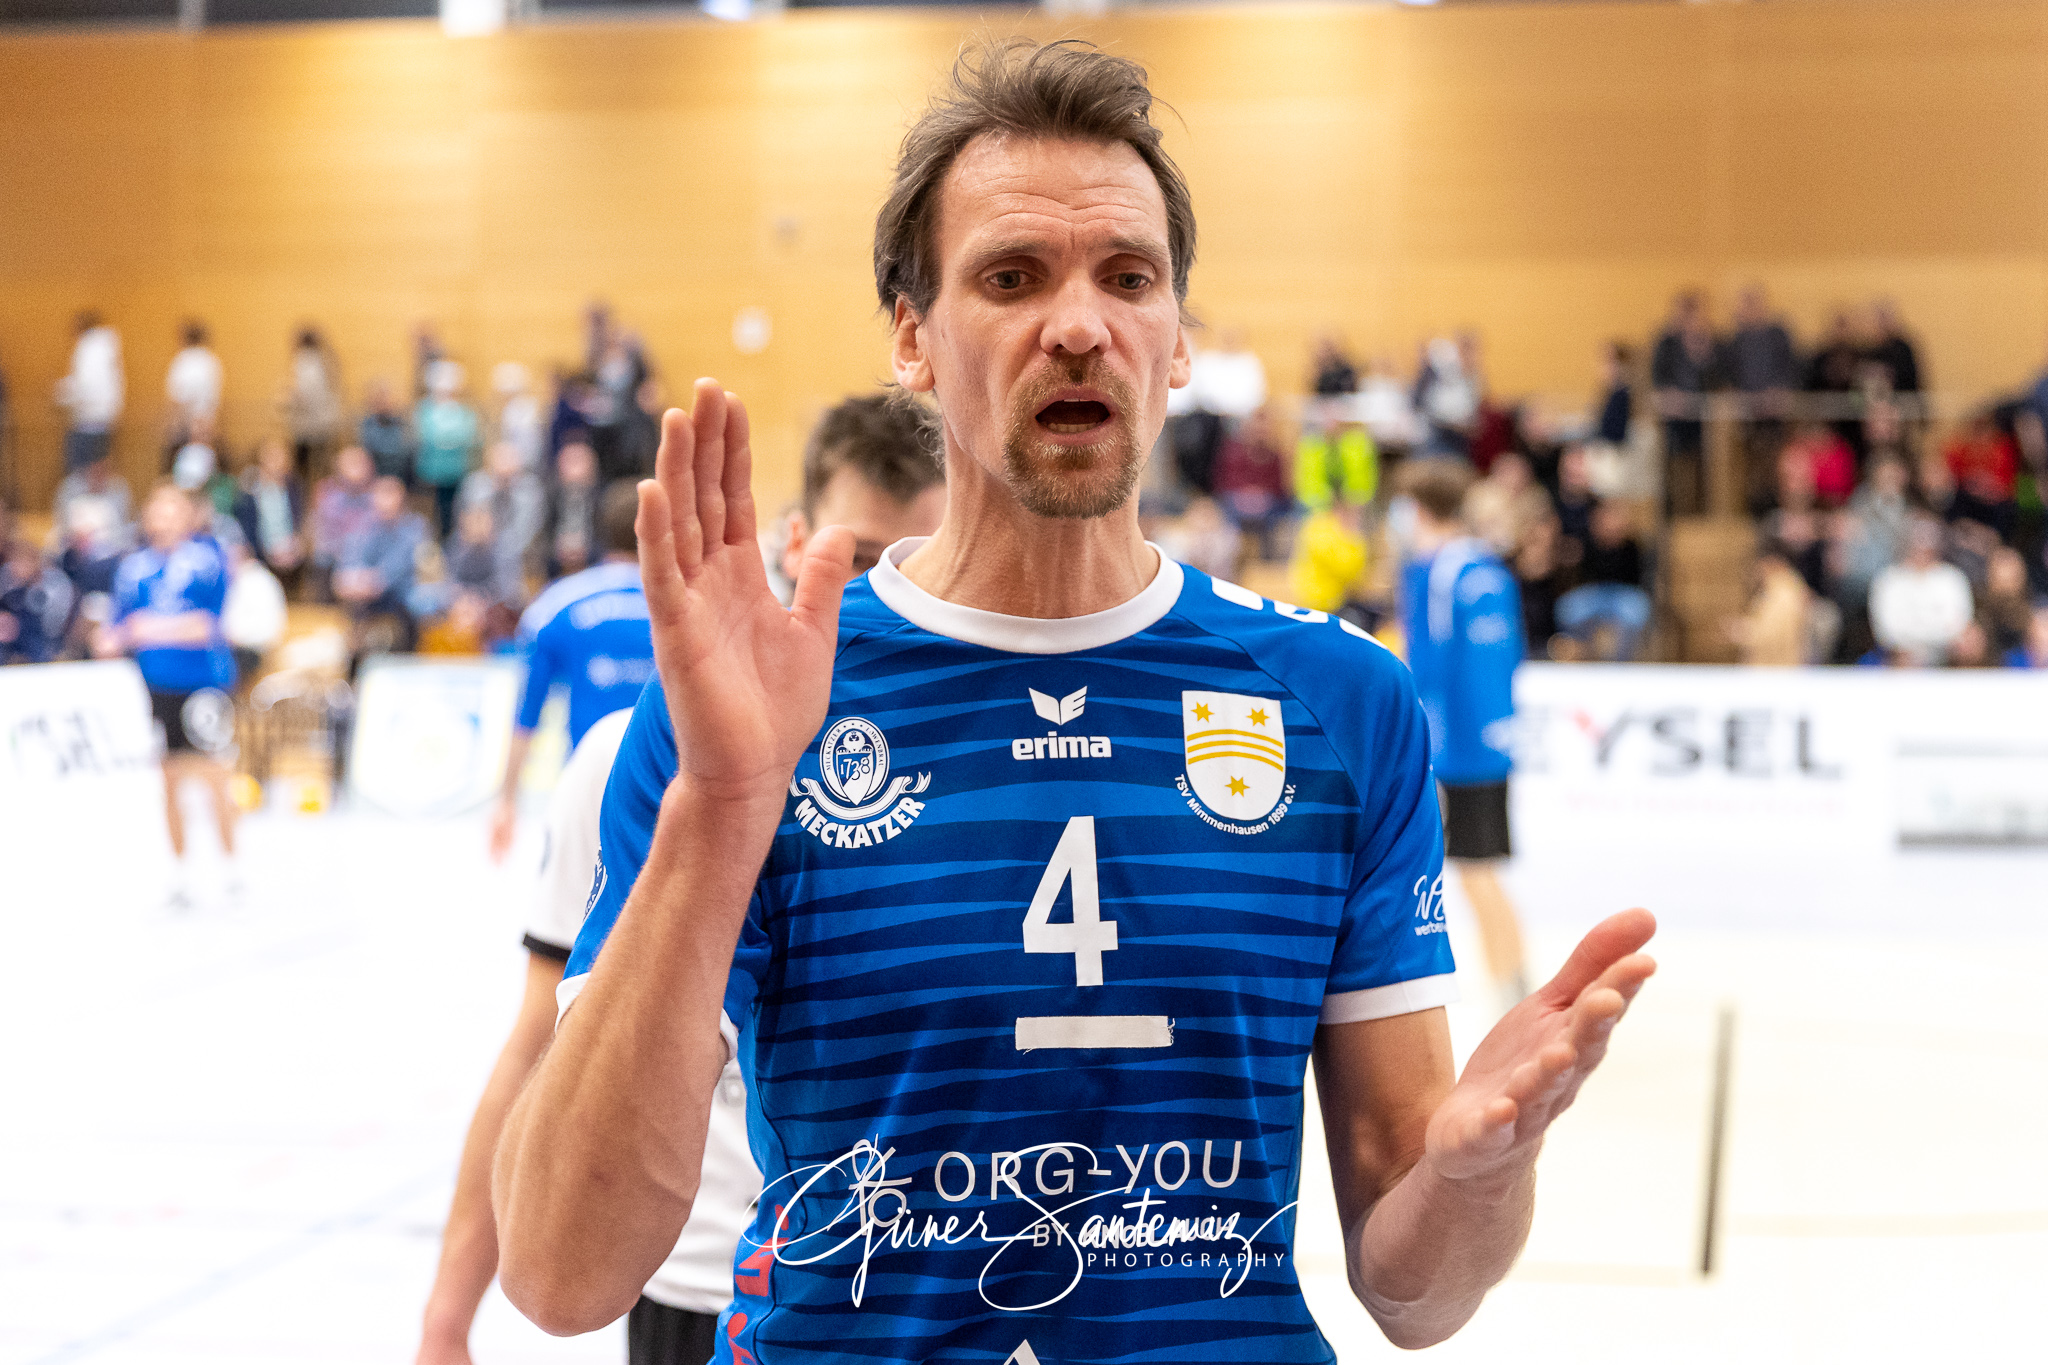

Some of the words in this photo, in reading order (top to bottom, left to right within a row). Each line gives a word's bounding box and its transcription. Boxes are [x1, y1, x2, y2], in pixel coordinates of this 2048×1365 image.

[840, 756, 871, 781] 1738
[1011, 730, 1112, 760] erima
[794, 796, 927, 849] MECKATZER
[1174, 773, 1193, 798] TSV
[1186, 797, 1270, 836] Mimmenhausen
[1267, 803, 1289, 826] 1899
[1284, 783, 1297, 805] e.V.
[1022, 815, 1119, 987] 4
[934, 1139, 1243, 1203] ORG-YOU
[1033, 1222, 1069, 1248] BY
